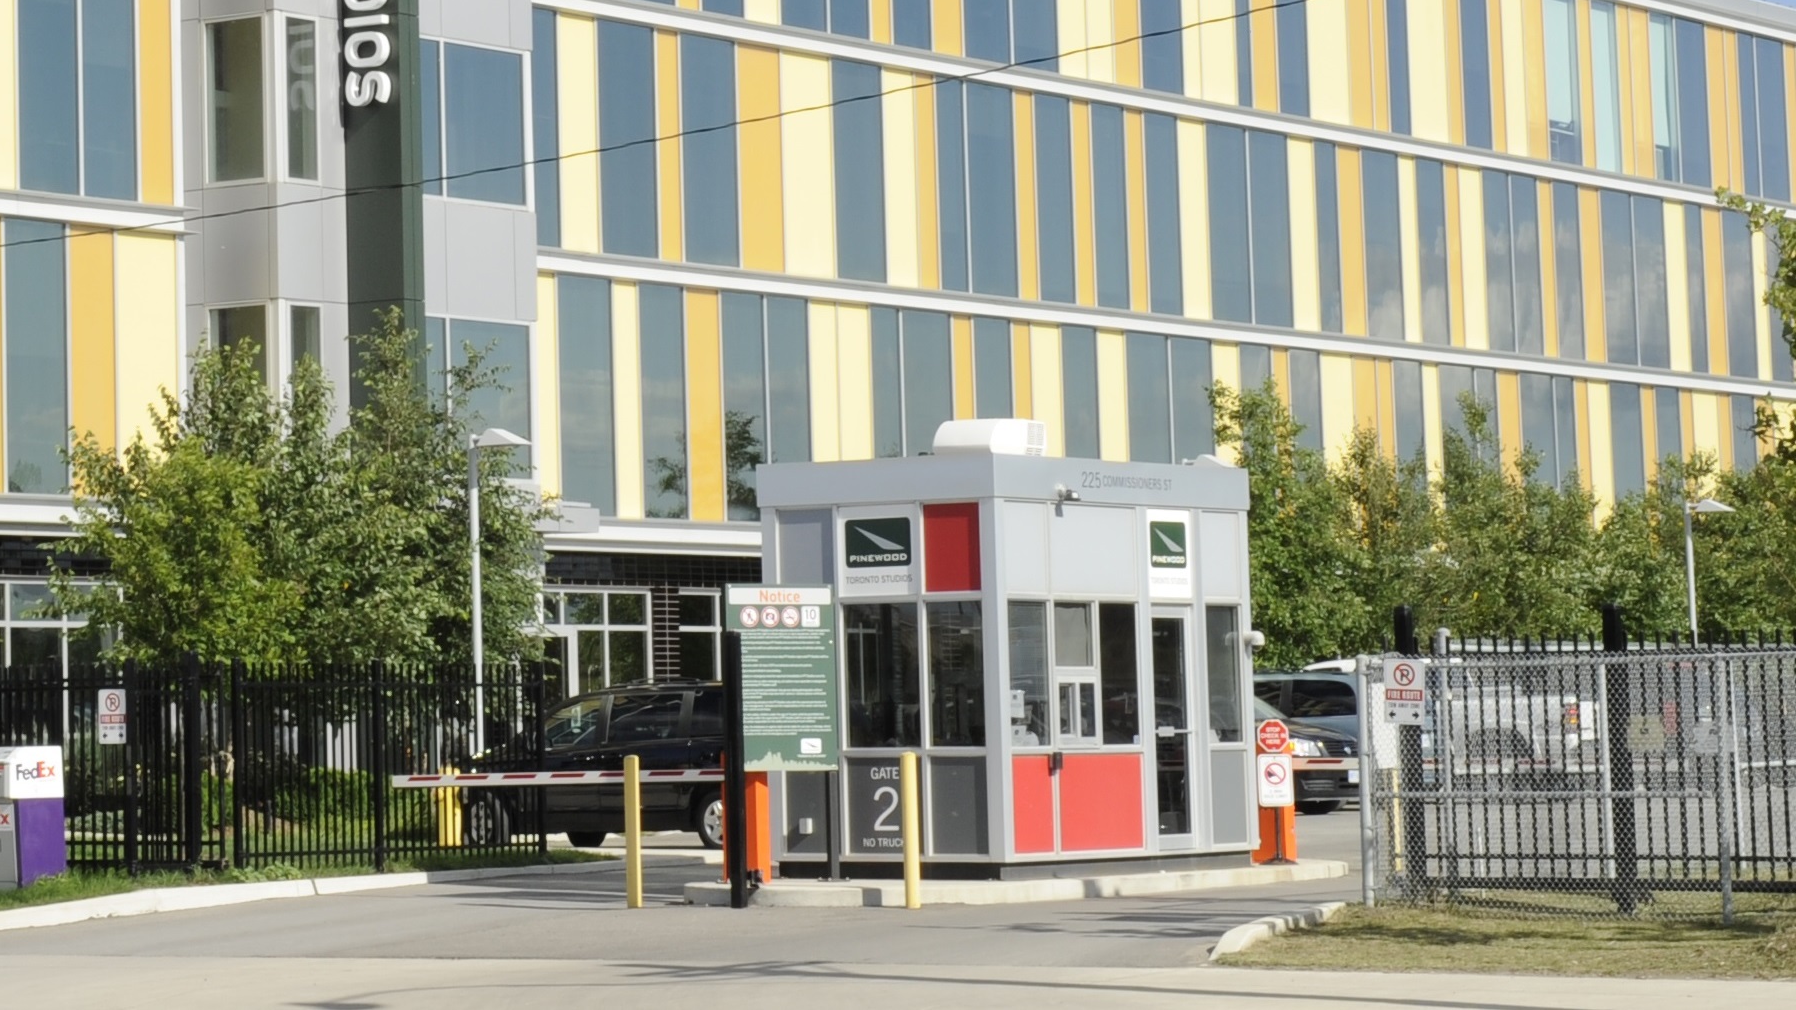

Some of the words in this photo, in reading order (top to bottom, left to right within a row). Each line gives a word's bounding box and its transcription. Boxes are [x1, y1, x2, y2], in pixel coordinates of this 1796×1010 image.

[1082, 471, 1101, 489] 225
[1103, 475, 1162, 490] COMMISSIONERS
[1163, 479, 1172, 491] ST
[850, 553, 908, 563] PINEWOOD
[845, 575, 879, 585] TORONTO
[881, 574, 913, 583] STUDIOS
[759, 590, 801, 603] Notice
[805, 609, 817, 620] 10
[16, 760, 55, 781] FedEx
[870, 766, 900, 780] GATE
[873, 786, 900, 831] 2
[863, 838, 876, 847] NO
